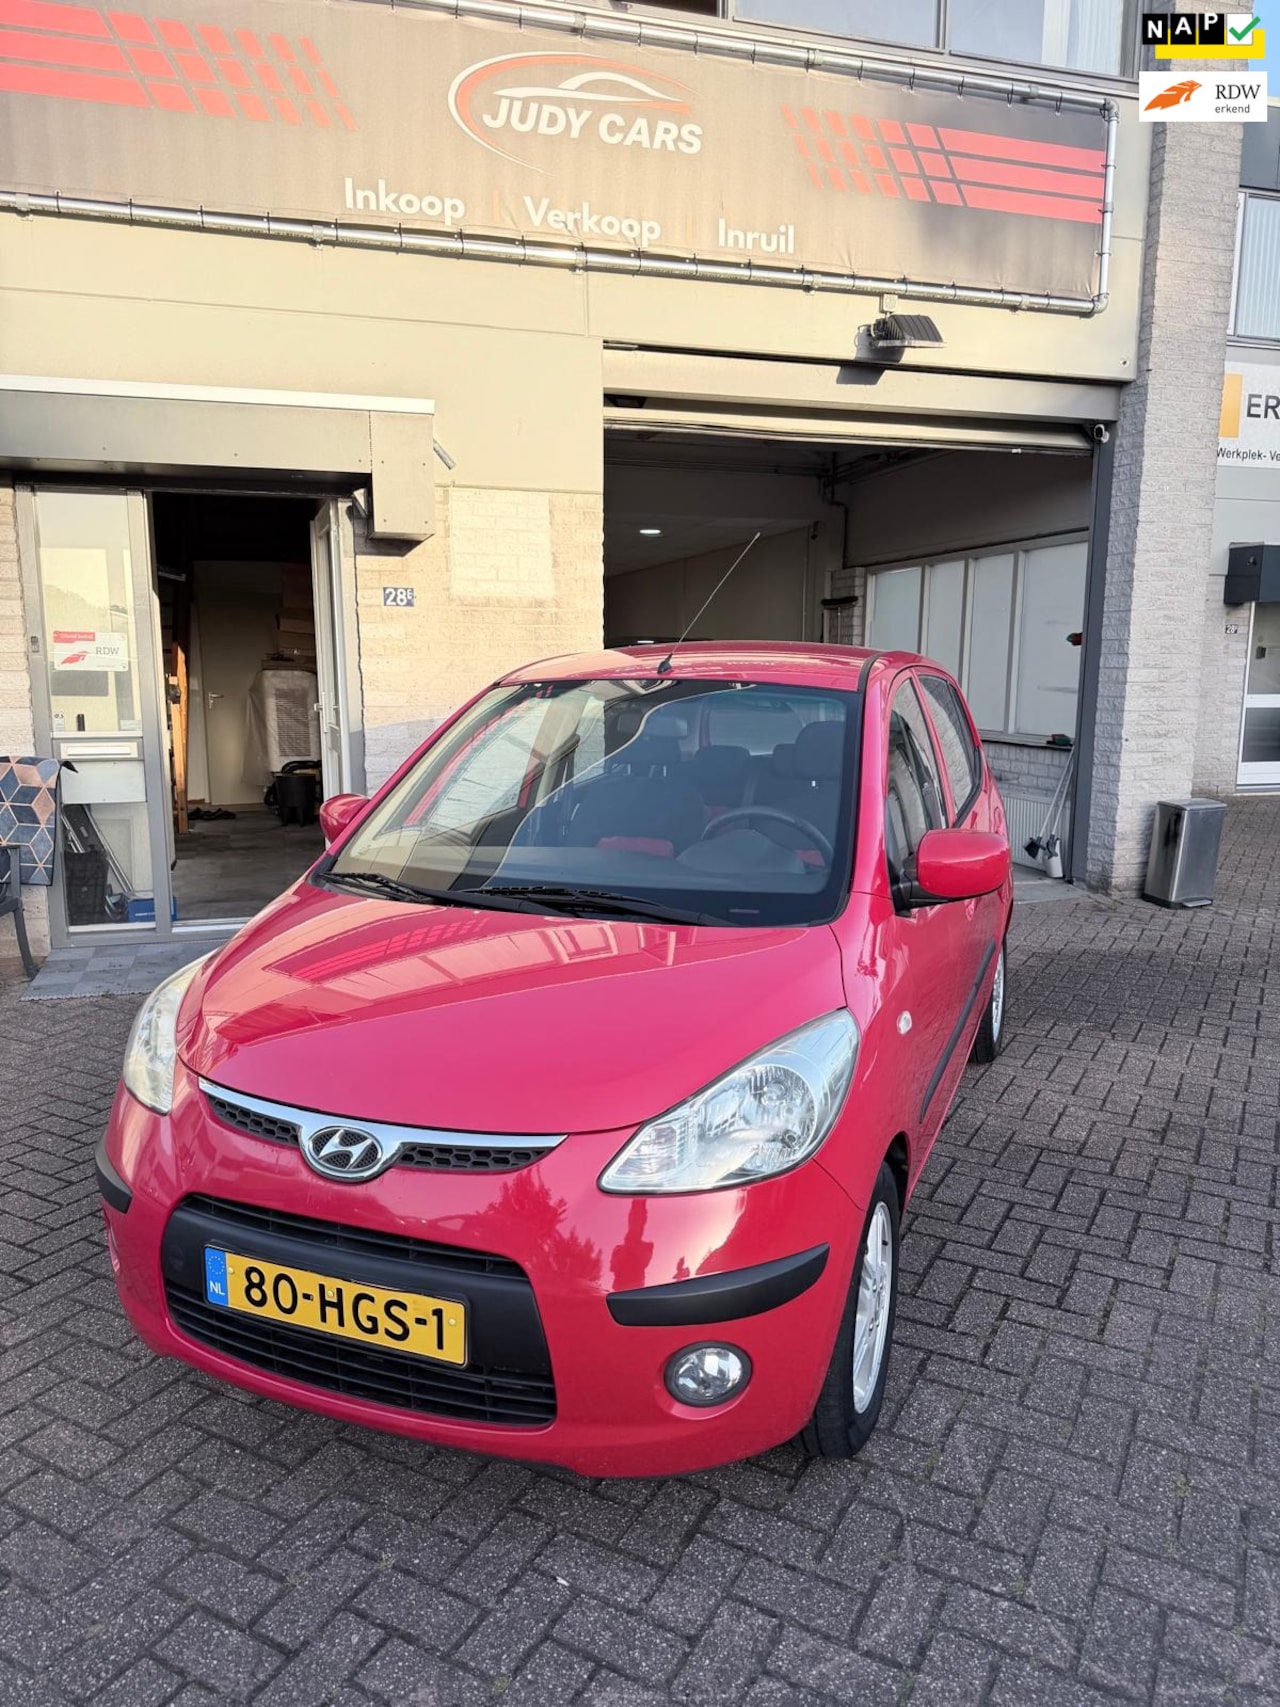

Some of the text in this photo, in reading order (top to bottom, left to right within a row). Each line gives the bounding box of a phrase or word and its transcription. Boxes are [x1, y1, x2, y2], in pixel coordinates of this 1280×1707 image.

[482, 98, 704, 155] JUDY CARS
[344, 177, 795, 254] Inkoop Verkoop Inruil
[95, 646, 120, 655] RDW
[209, 1266, 444, 1351] NL 80-HGS-1
